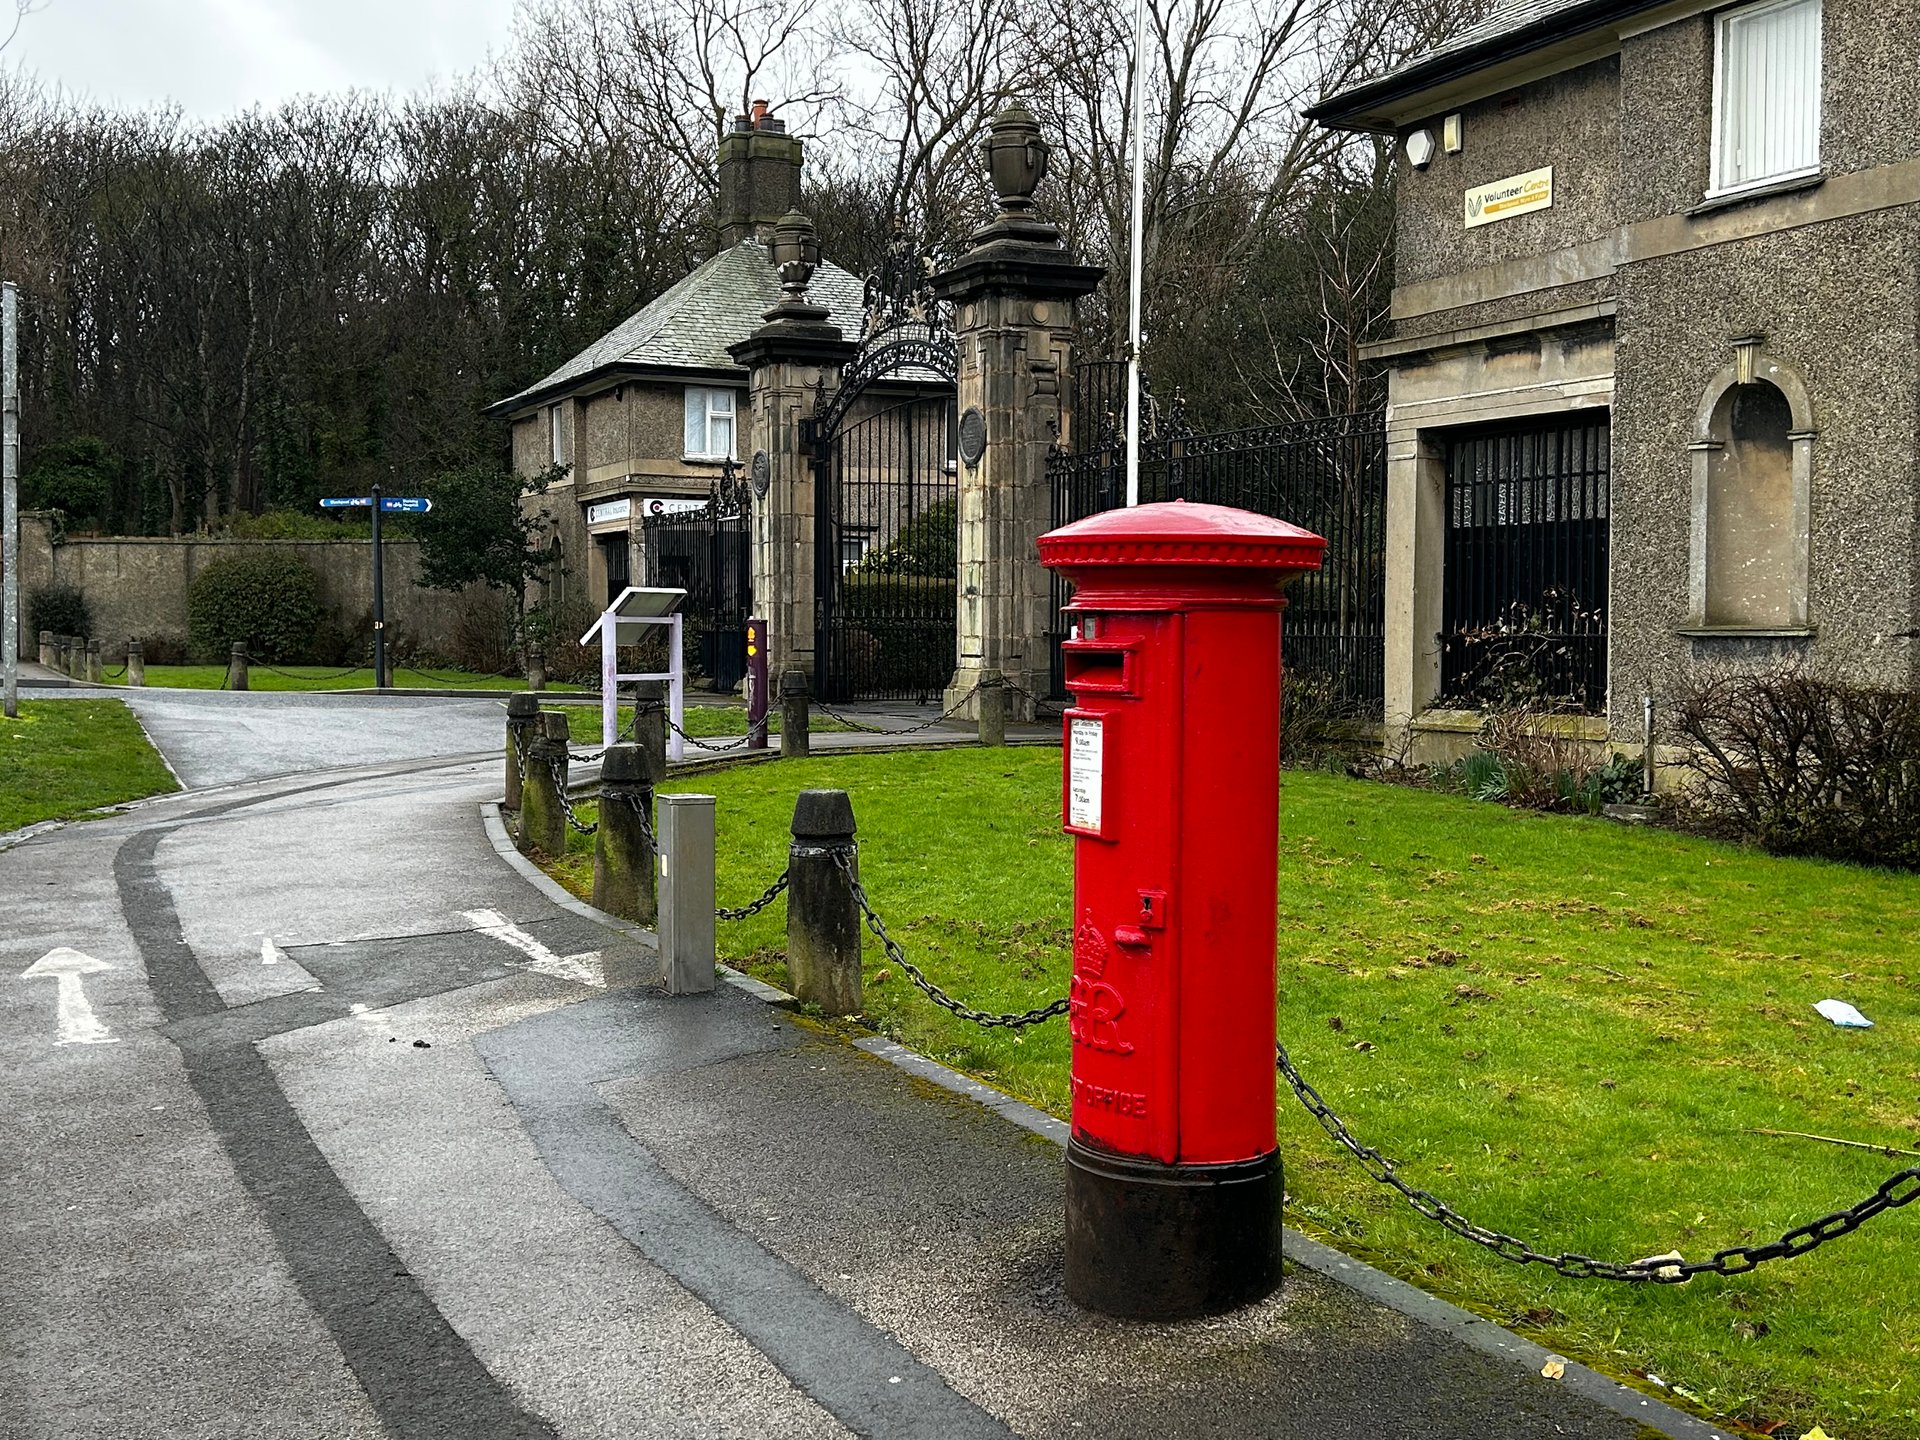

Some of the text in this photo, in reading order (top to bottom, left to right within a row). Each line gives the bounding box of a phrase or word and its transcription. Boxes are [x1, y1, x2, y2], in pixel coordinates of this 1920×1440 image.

[1484, 179, 1550, 204] Volunteer Centre
[1086, 1084, 1148, 1118] OFFICE
